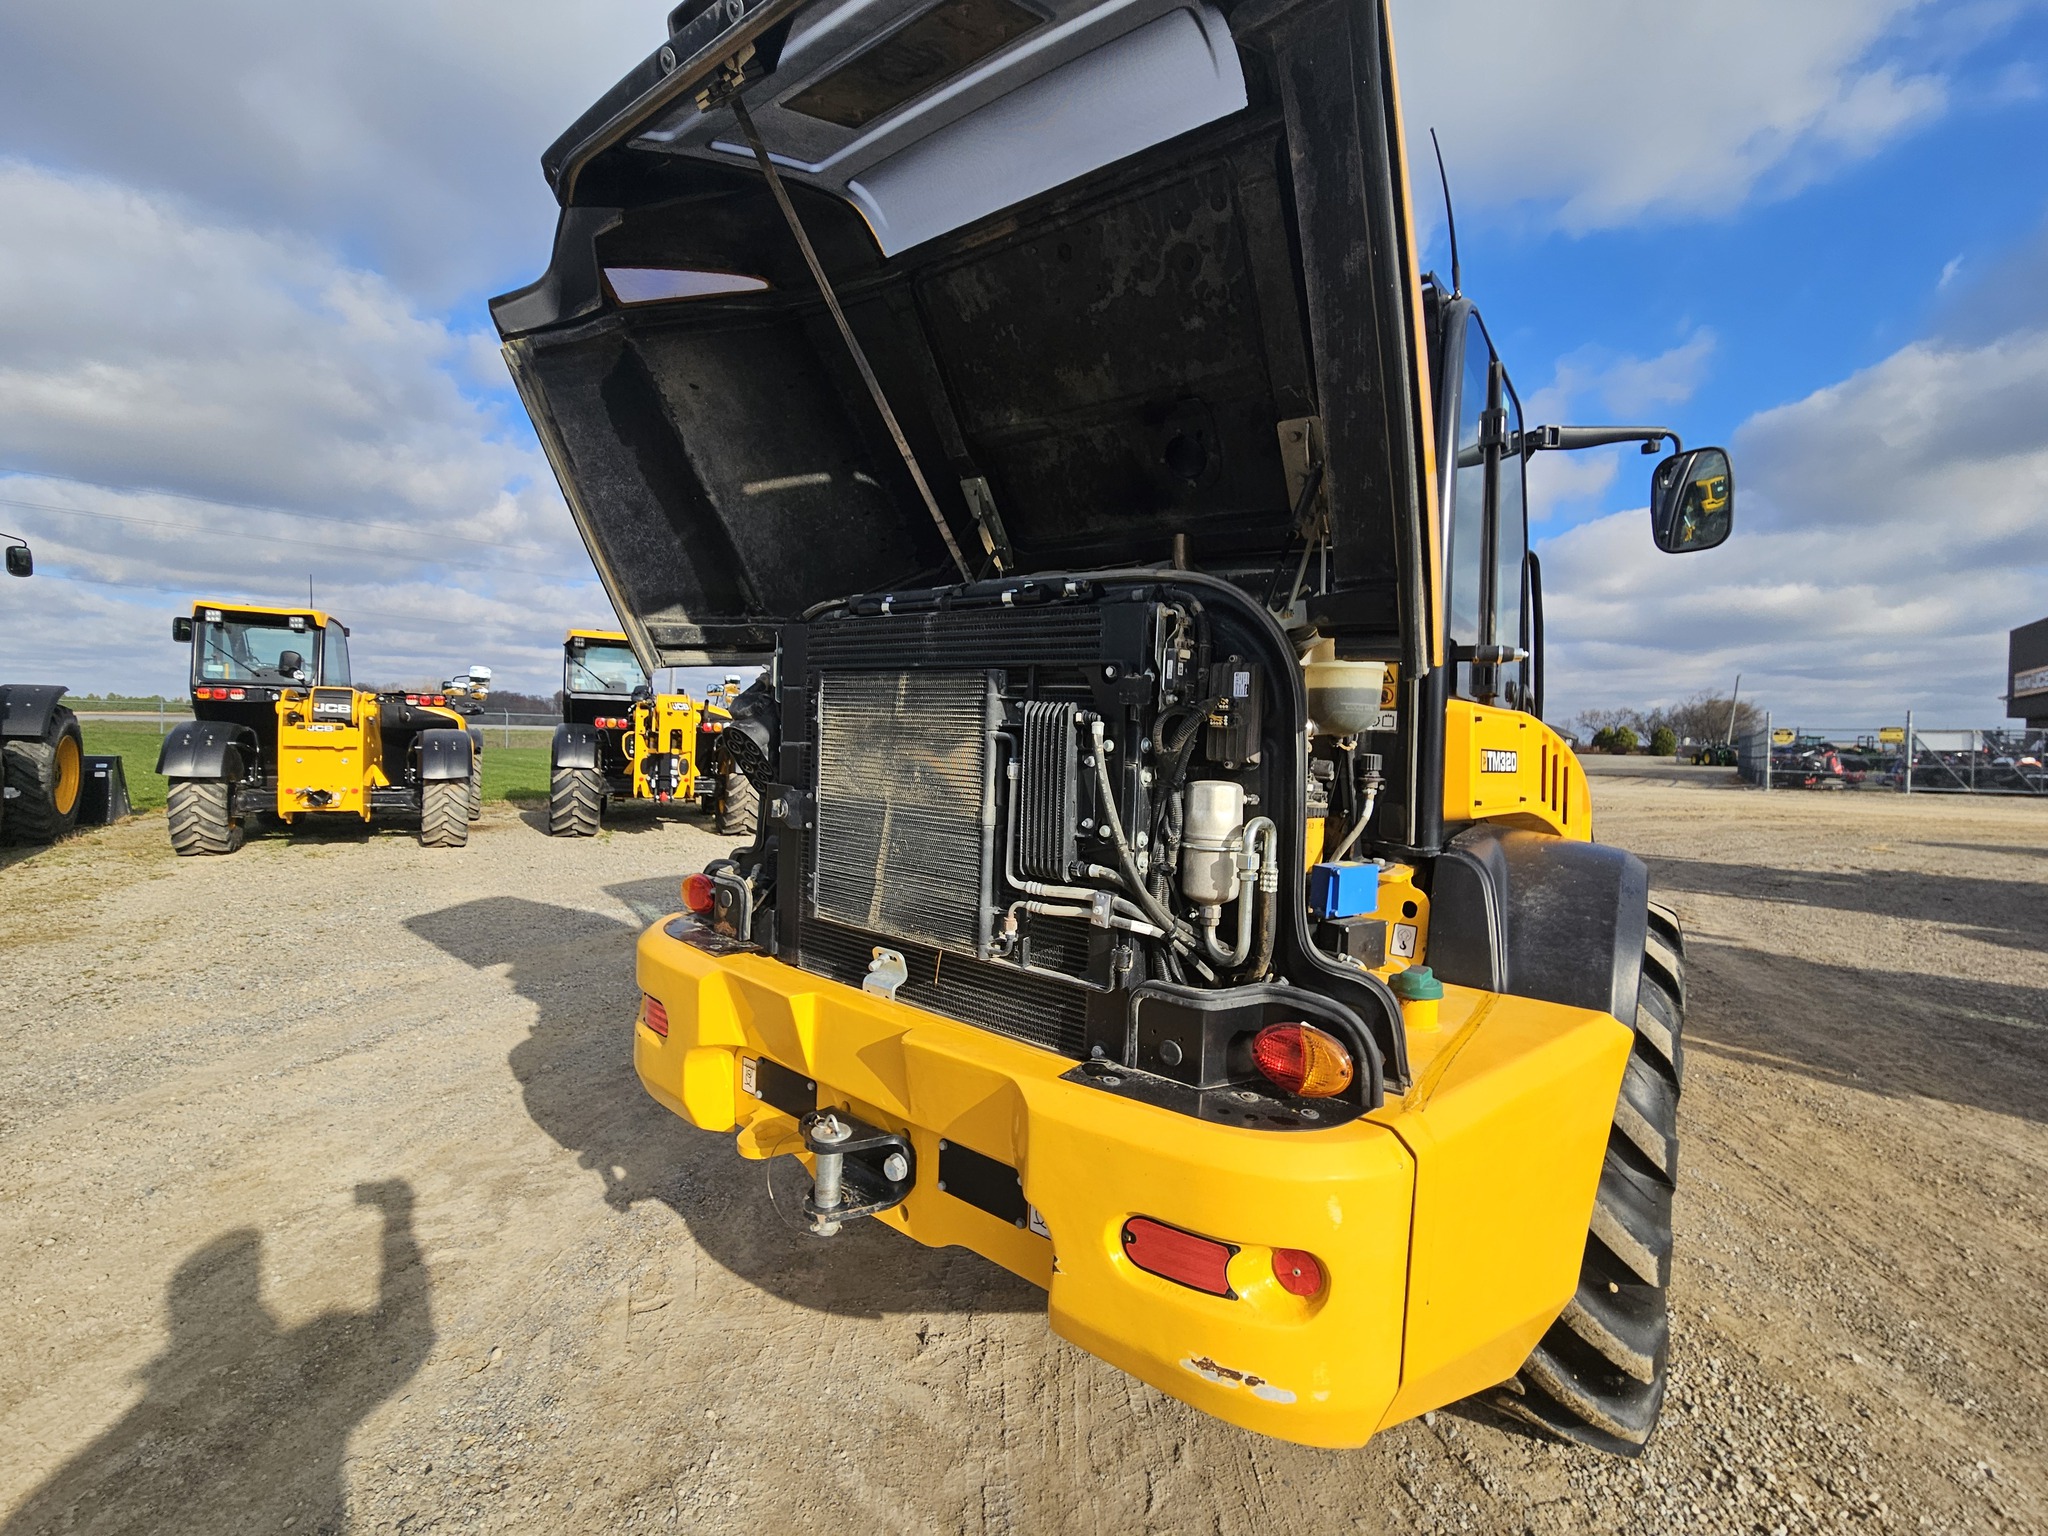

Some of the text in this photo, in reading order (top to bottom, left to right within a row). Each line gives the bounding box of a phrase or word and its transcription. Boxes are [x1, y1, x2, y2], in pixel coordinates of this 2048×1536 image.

[313, 702, 351, 713] JCB
[671, 702, 690, 711] JCB
[1487, 750, 1517, 772] TM320
